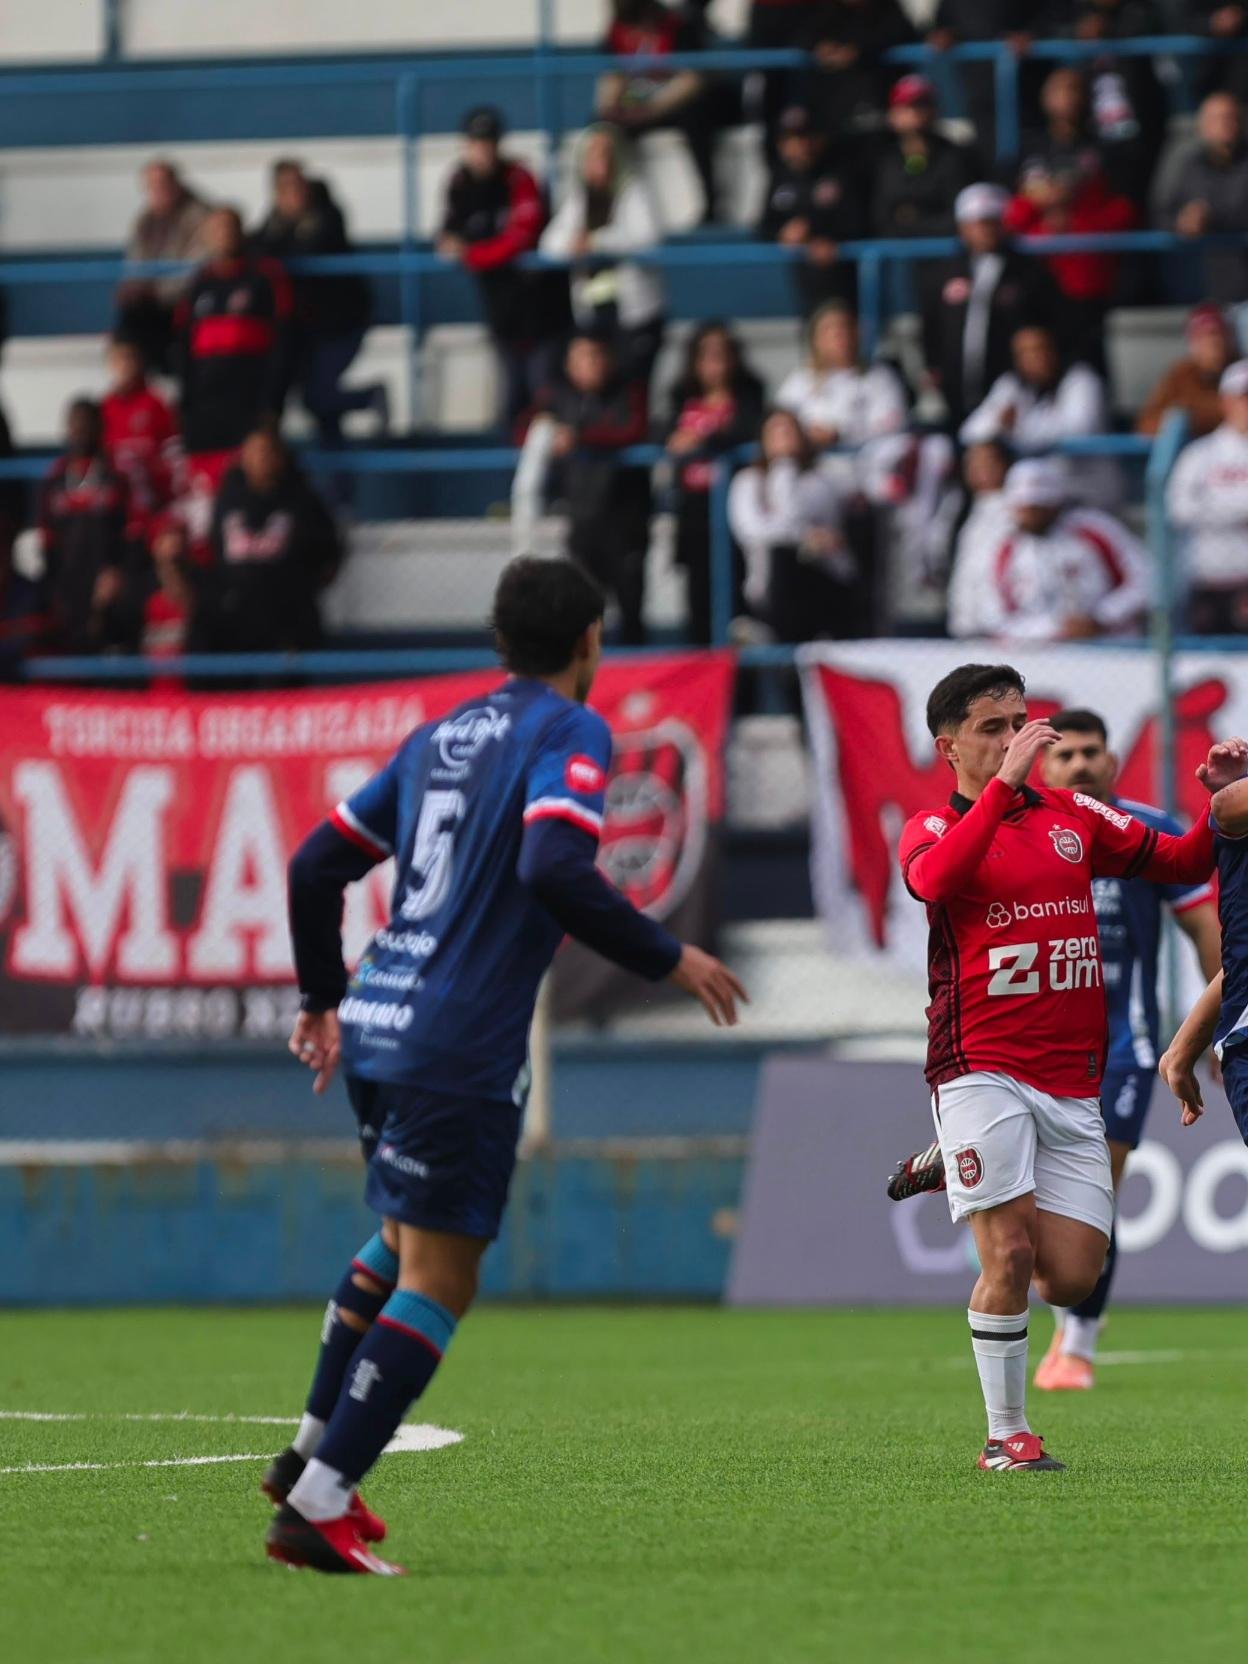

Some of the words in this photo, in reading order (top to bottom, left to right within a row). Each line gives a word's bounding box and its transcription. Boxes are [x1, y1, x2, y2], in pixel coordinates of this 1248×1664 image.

[400, 789, 465, 920] 5
[1014, 896, 1089, 921] banrisul
[1048, 936, 1097, 961] zero
[1050, 957, 1100, 991] um
